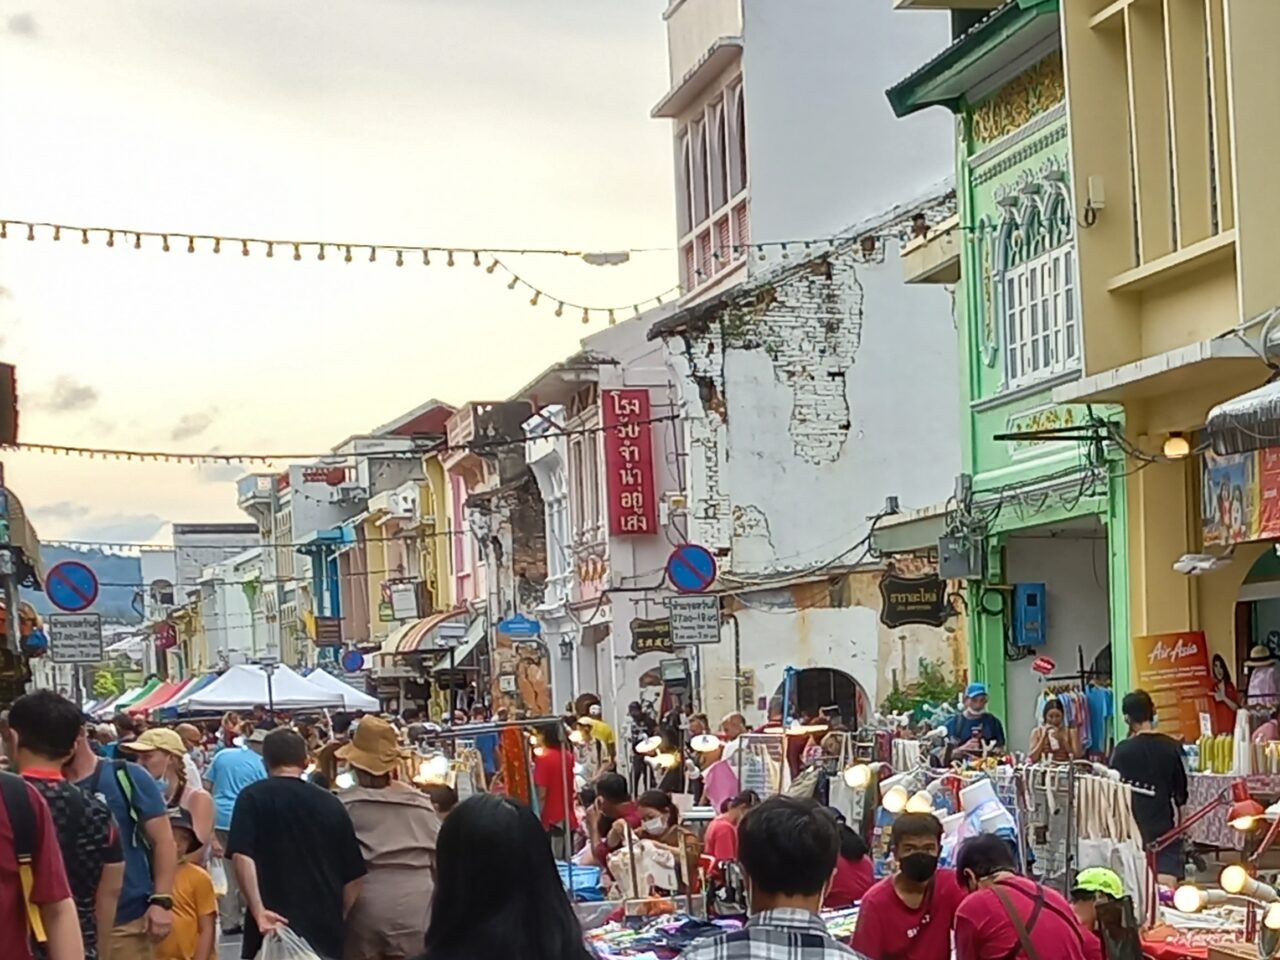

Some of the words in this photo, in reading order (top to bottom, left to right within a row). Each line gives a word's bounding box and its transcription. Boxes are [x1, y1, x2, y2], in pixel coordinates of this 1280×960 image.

[610, 391, 640, 414] โรง
[619, 440, 639, 461] จำ
[619, 463, 642, 485] นำ
[621, 488, 643, 514] อยู่
